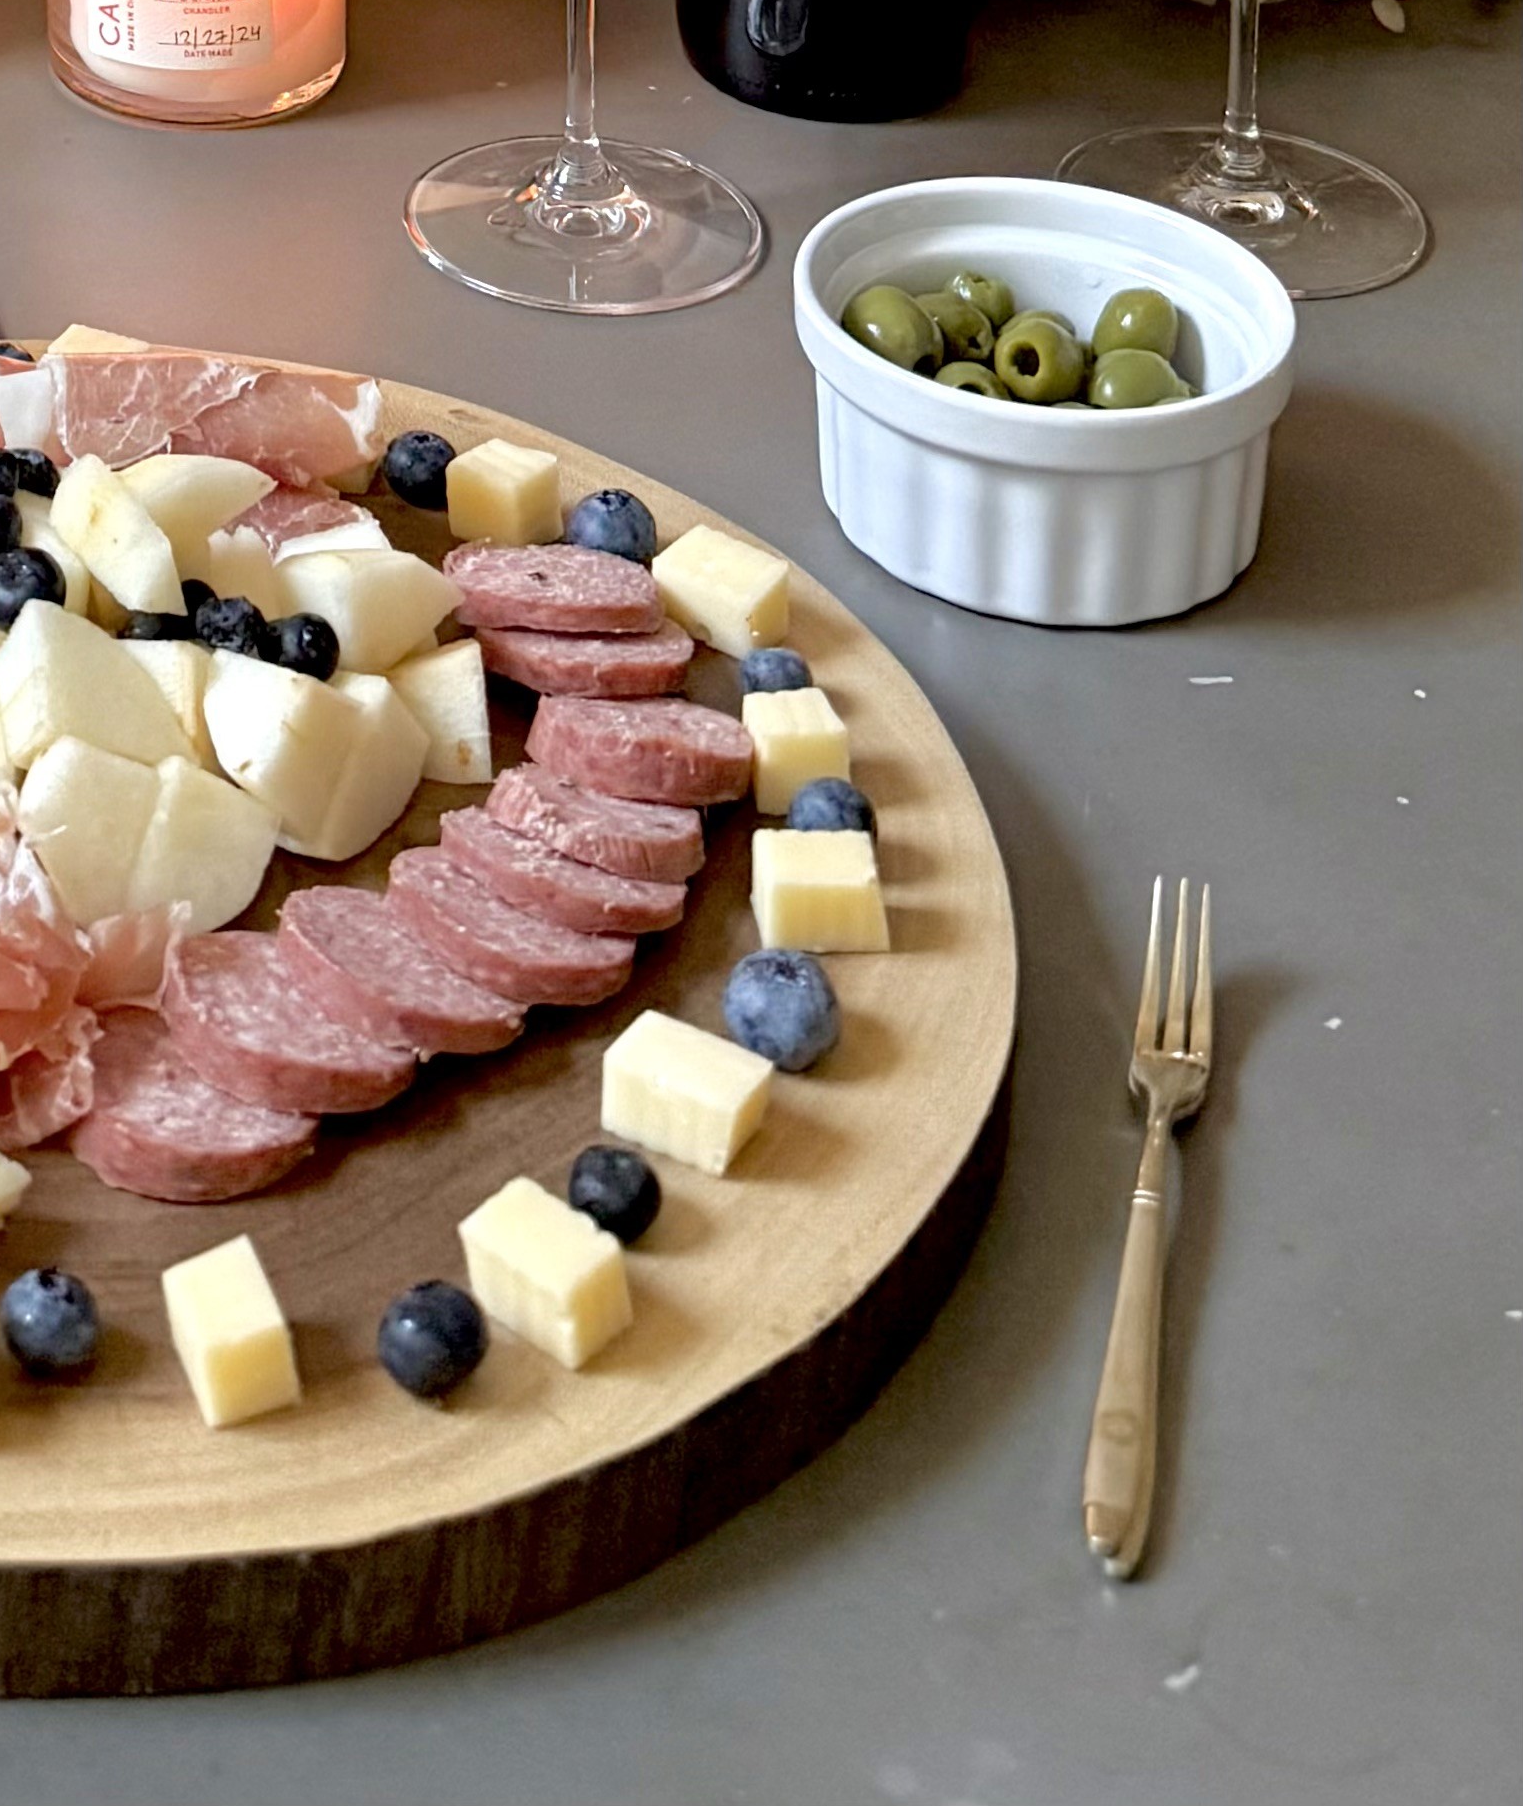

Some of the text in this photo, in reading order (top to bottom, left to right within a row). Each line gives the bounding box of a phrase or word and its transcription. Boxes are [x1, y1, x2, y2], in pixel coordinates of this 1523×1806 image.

[182, 5, 231, 15] CHANDLER
[127, 11, 135, 22] IN
[127, 24, 136, 52] MADE
[174, 24, 262, 50] 12/27/24
[183, 48, 233, 58] DATE MADE
